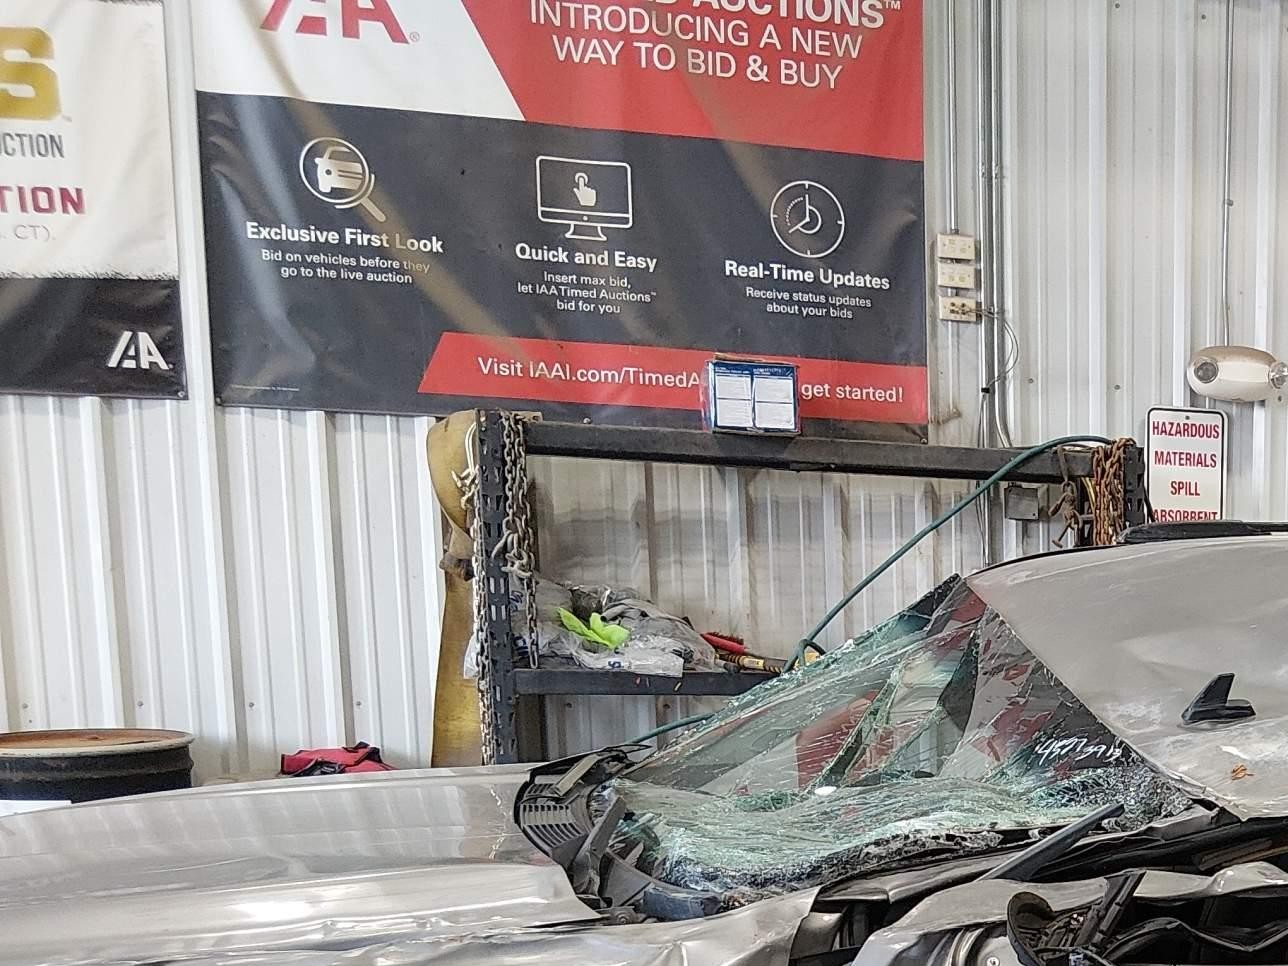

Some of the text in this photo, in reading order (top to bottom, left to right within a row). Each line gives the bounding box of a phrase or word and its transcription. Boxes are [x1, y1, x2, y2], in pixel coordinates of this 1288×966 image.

[530, 0, 862, 58] INTRODUCING A NEW
[552, 34, 842, 88] WAY TO BID & BUY
[0, 132, 64, 158] CTION
[246, 221, 444, 253] Exclusive First Look
[261, 249, 430, 274] Bid on vehicles before they
[515, 243, 657, 272] Quick and Easy
[281, 266, 412, 284] go to the live auction
[544, 271, 631, 289] Insert max bid,
[724, 260, 890, 290] Real-Time Updates
[517, 282, 533, 294] let
[536, 284, 558, 296] IAA
[558, 286, 597, 299] Timed
[746, 286, 872, 308] Receive status updates
[557, 300, 620, 314] bid for you
[766, 302, 853, 319] about your bids
[478, 357, 523, 378] Visit
[801, 383, 831, 400] get
[835, 385, 903, 403] started!
[1152, 421, 1220, 439] HAZARDOUS
[1154, 451, 1217, 468] MATERIALS
[1170, 480, 1200, 496] SPILL
